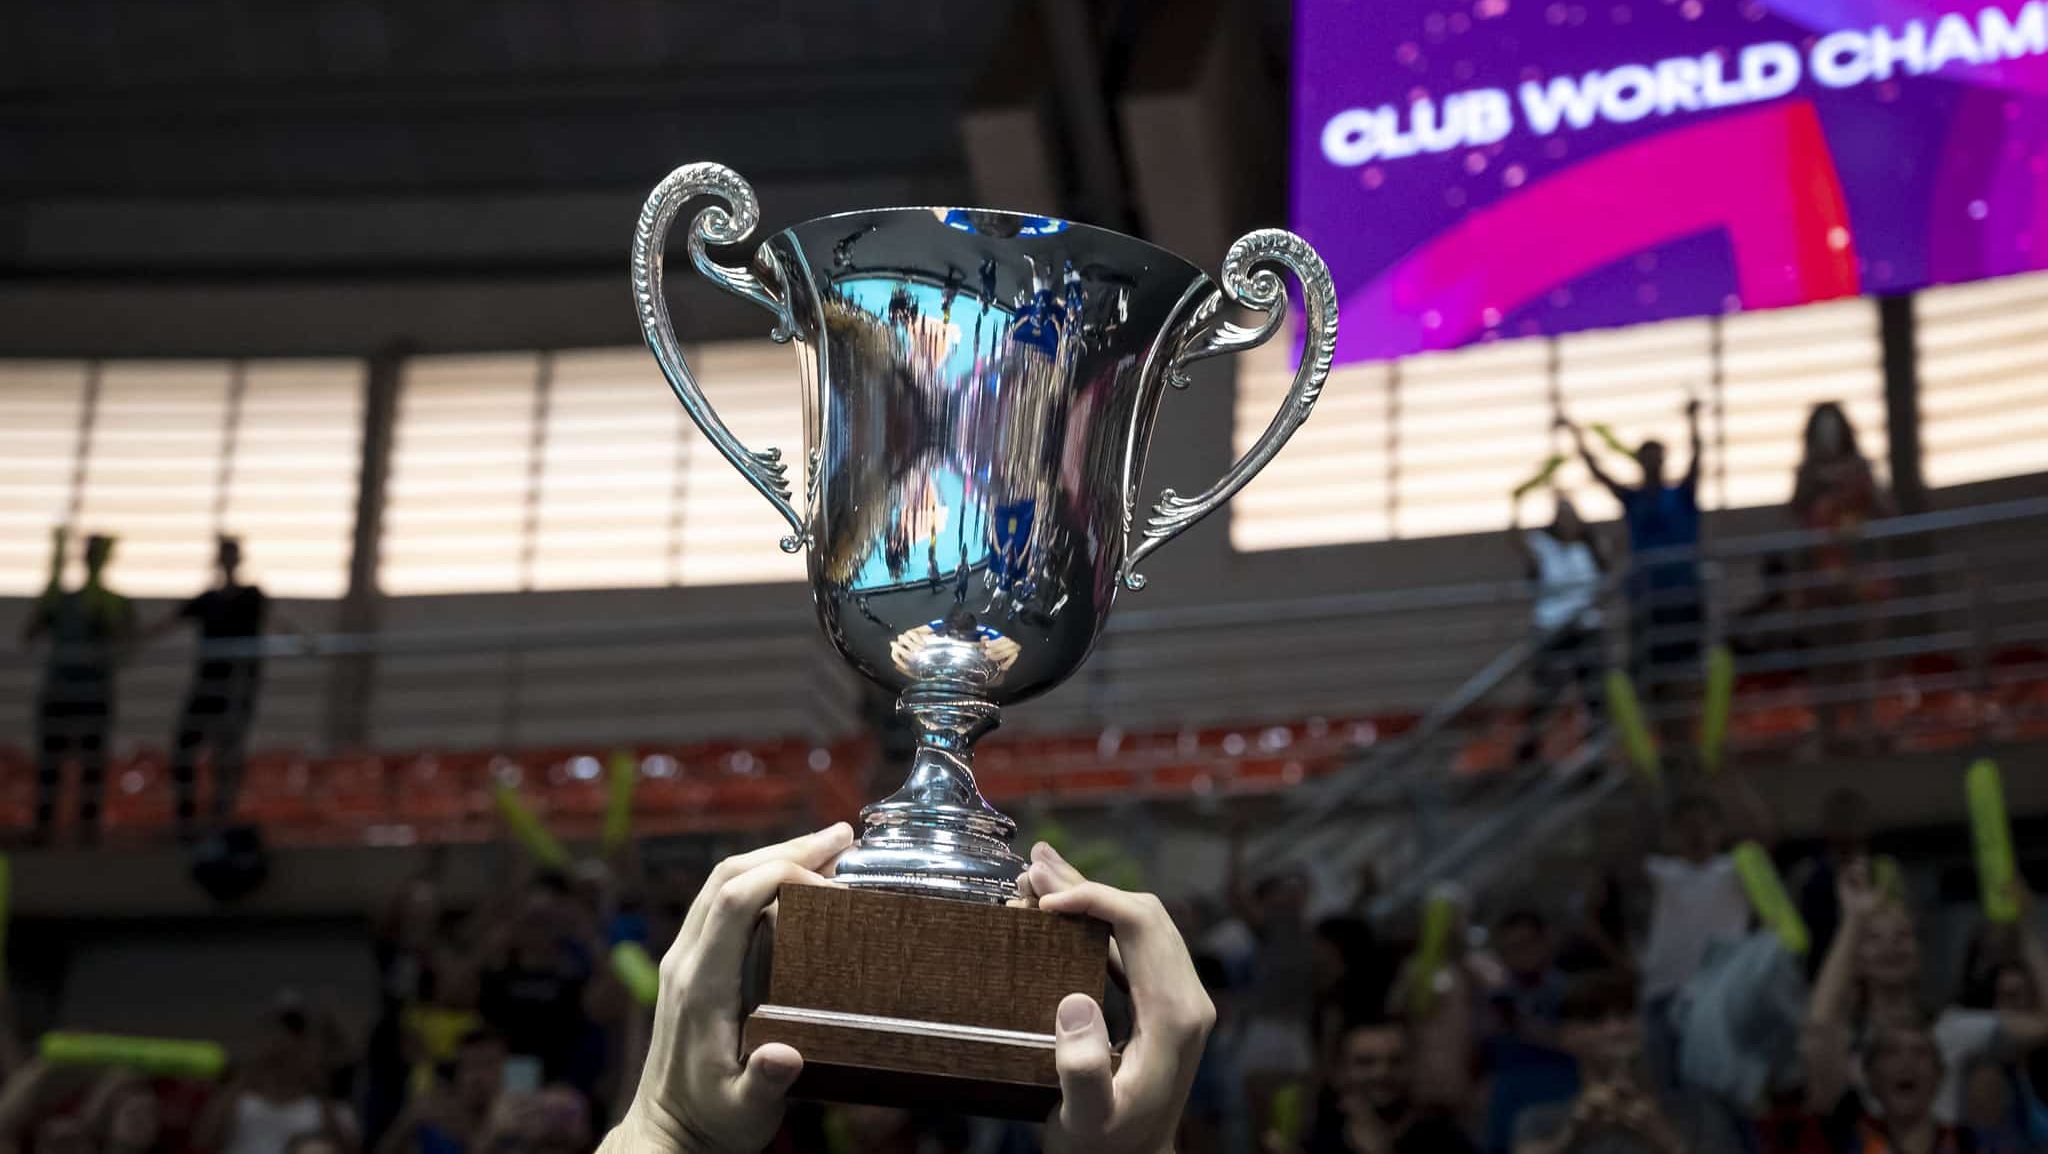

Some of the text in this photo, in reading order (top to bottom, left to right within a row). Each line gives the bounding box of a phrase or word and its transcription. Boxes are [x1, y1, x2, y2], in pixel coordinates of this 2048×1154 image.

[1321, 1, 2048, 166] CLUB WORLD CHAM
